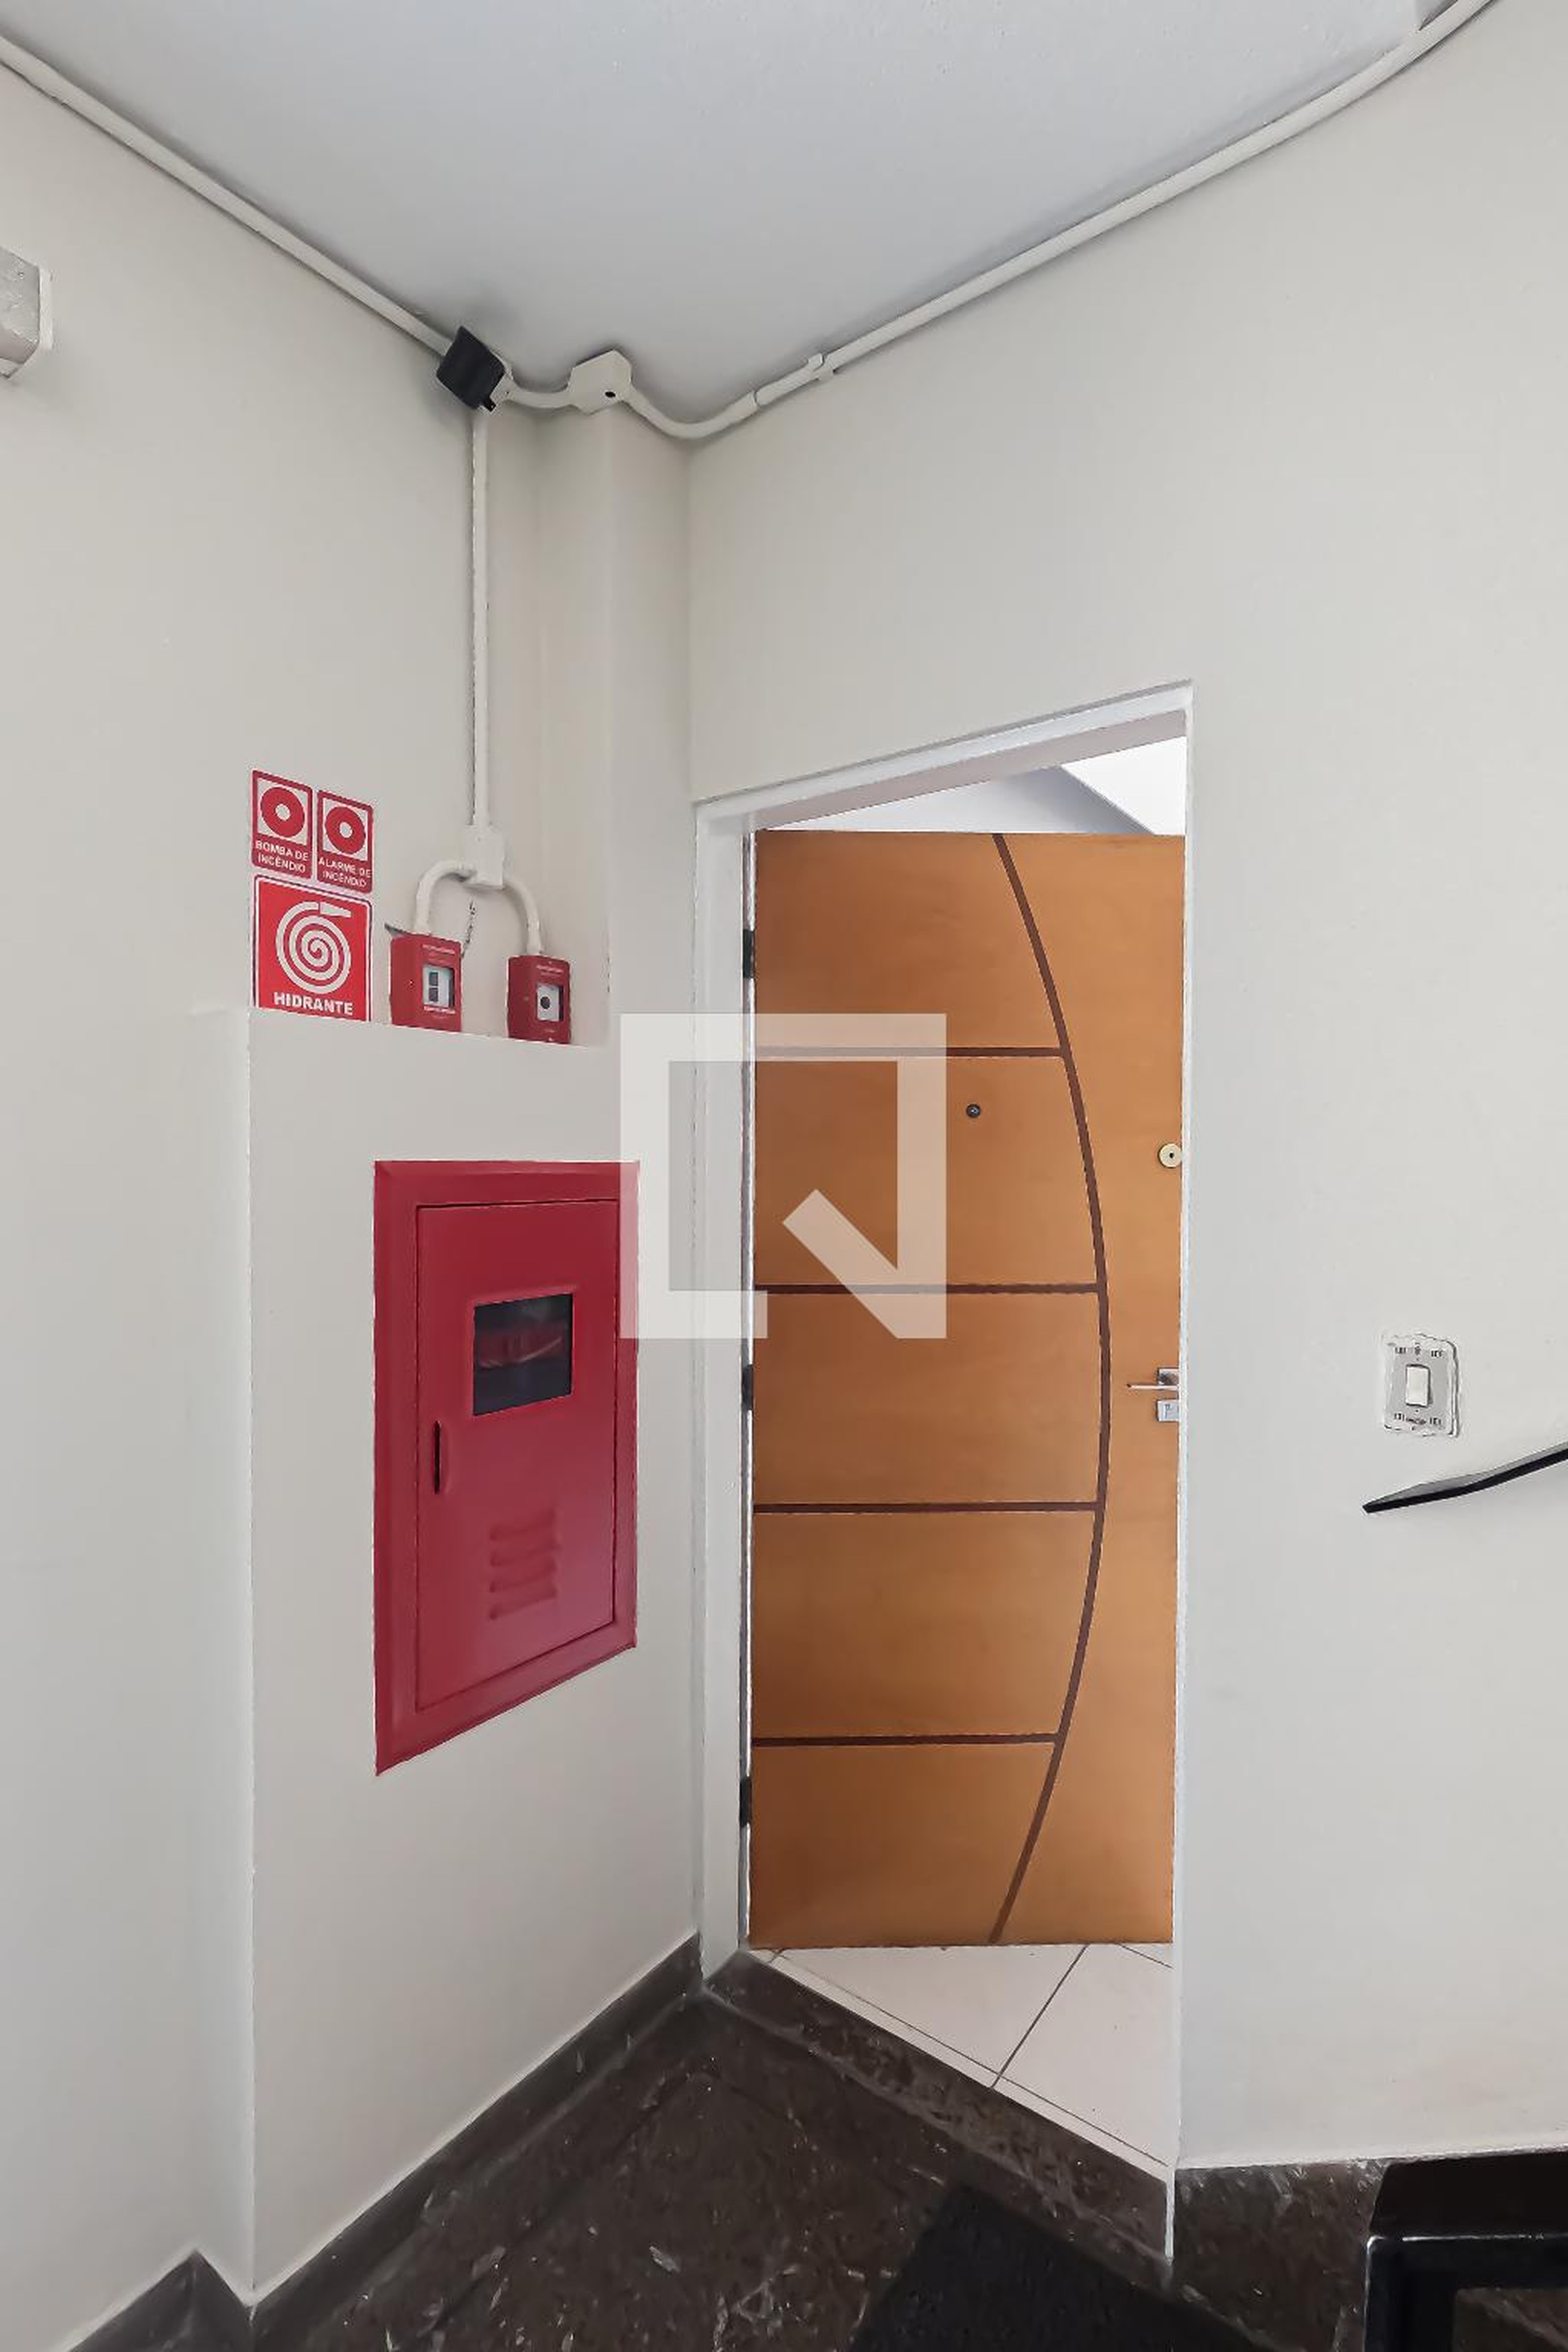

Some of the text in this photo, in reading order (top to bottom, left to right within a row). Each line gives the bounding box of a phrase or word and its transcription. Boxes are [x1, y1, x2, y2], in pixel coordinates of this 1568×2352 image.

[255, 841, 308, 861] BOMBA DE
[258, 853, 305, 873] INCÊNDIO
[318, 857, 371, 878] ALARME DE
[274, 992, 353, 1016] HIDRANTE
